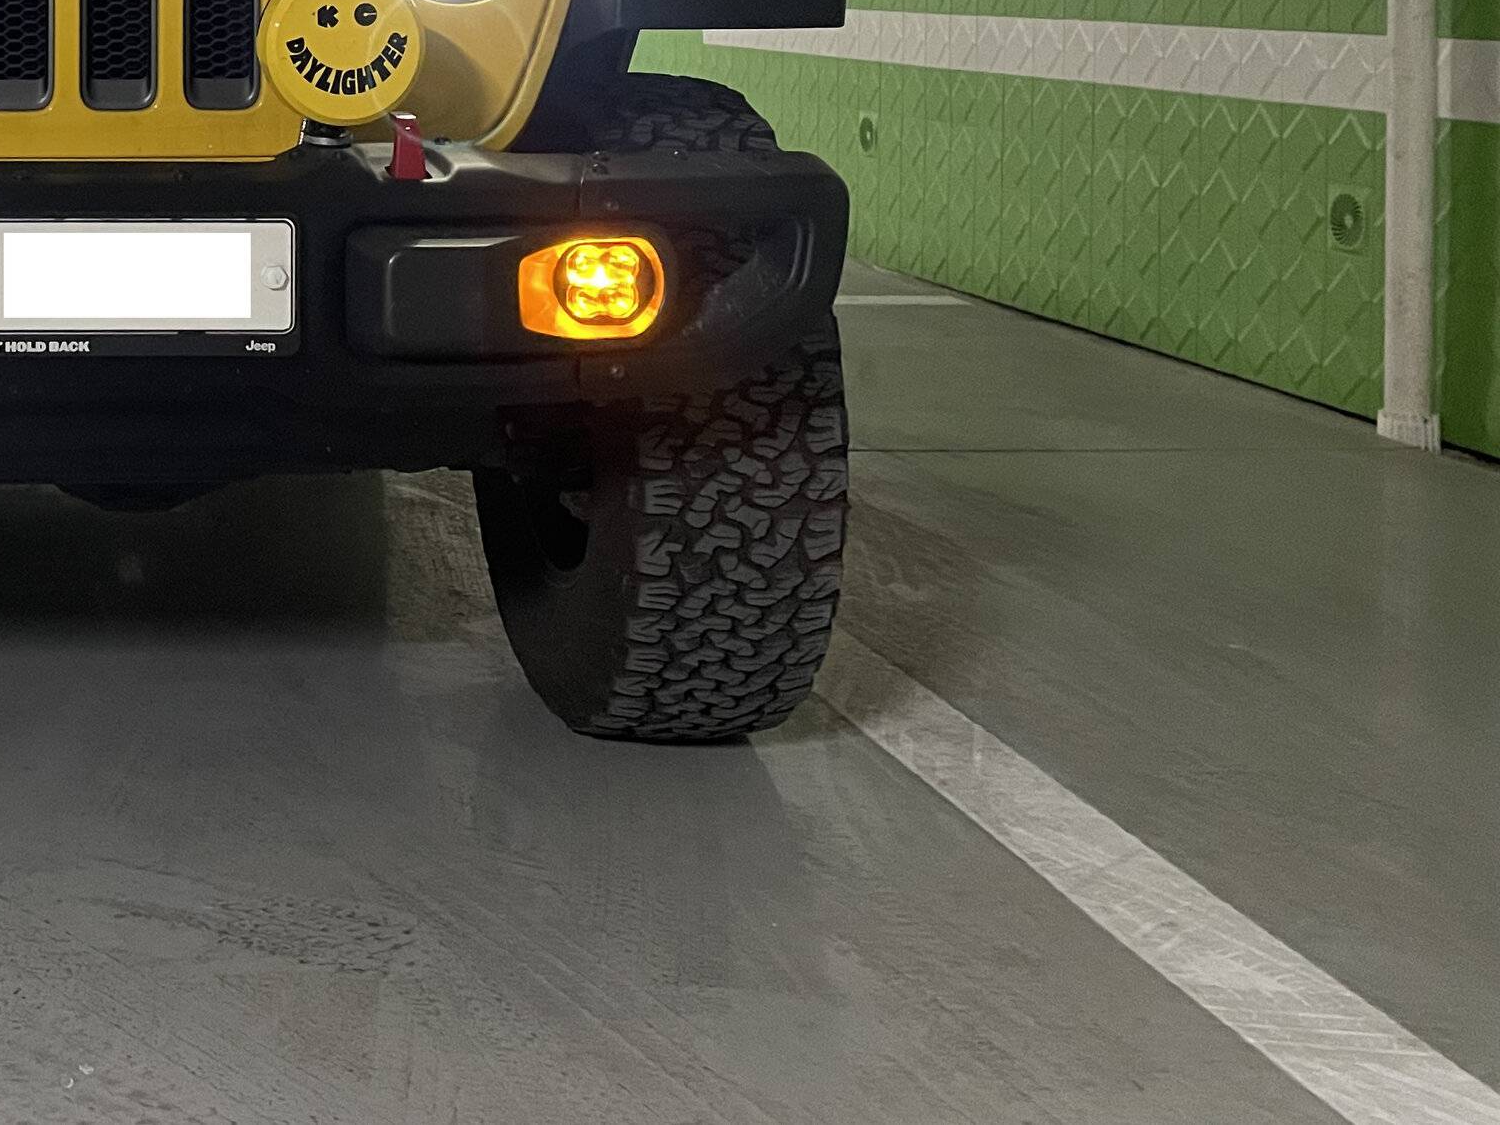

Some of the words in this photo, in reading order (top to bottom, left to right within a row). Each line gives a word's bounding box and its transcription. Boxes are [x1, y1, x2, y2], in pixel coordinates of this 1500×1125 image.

[286, 32, 407, 95] DAYLIGHTER
[5, 341, 46, 353] HOLD
[49, 341, 90, 353] BACK
[245, 340, 276, 353] Jeep
